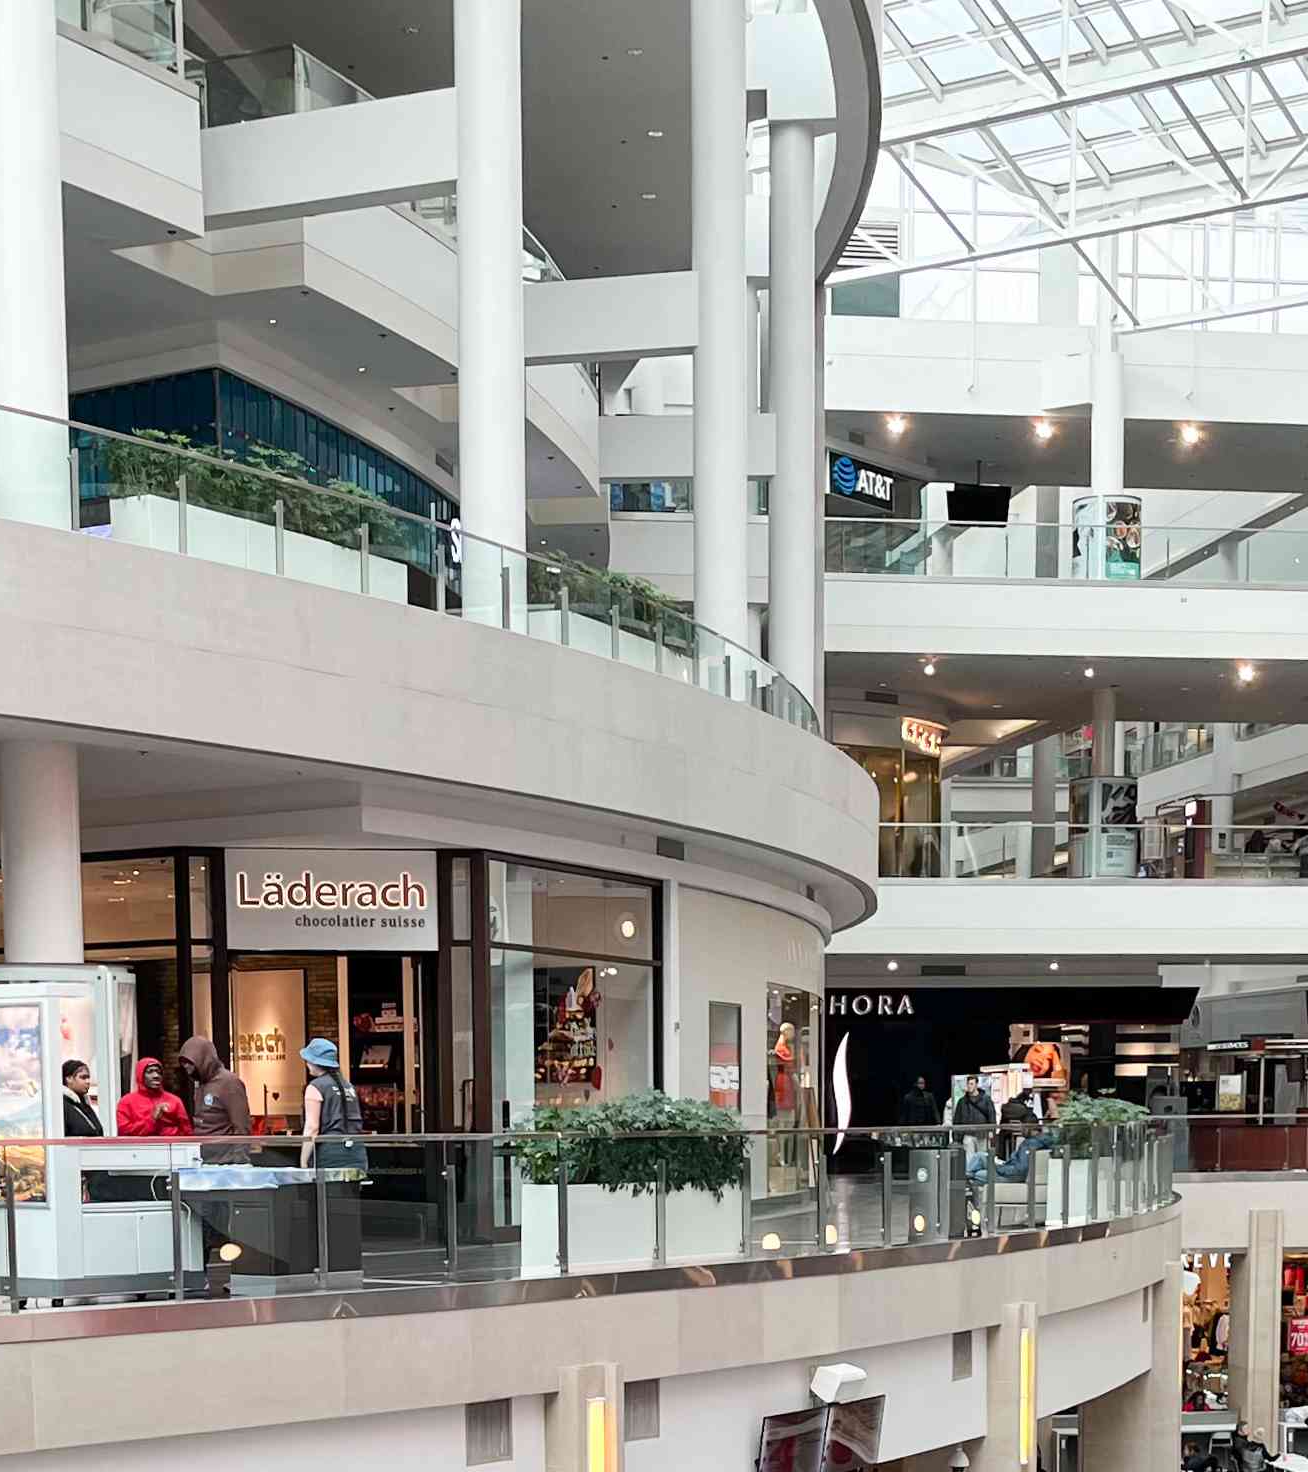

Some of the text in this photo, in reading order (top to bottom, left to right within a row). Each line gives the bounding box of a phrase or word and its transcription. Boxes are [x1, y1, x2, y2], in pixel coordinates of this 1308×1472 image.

[855, 469, 893, 501] AT&T
[238, 872, 427, 908] Läderach
[295, 914, 426, 928] chocolatier suisse
[829, 994, 916, 1016] HORA
